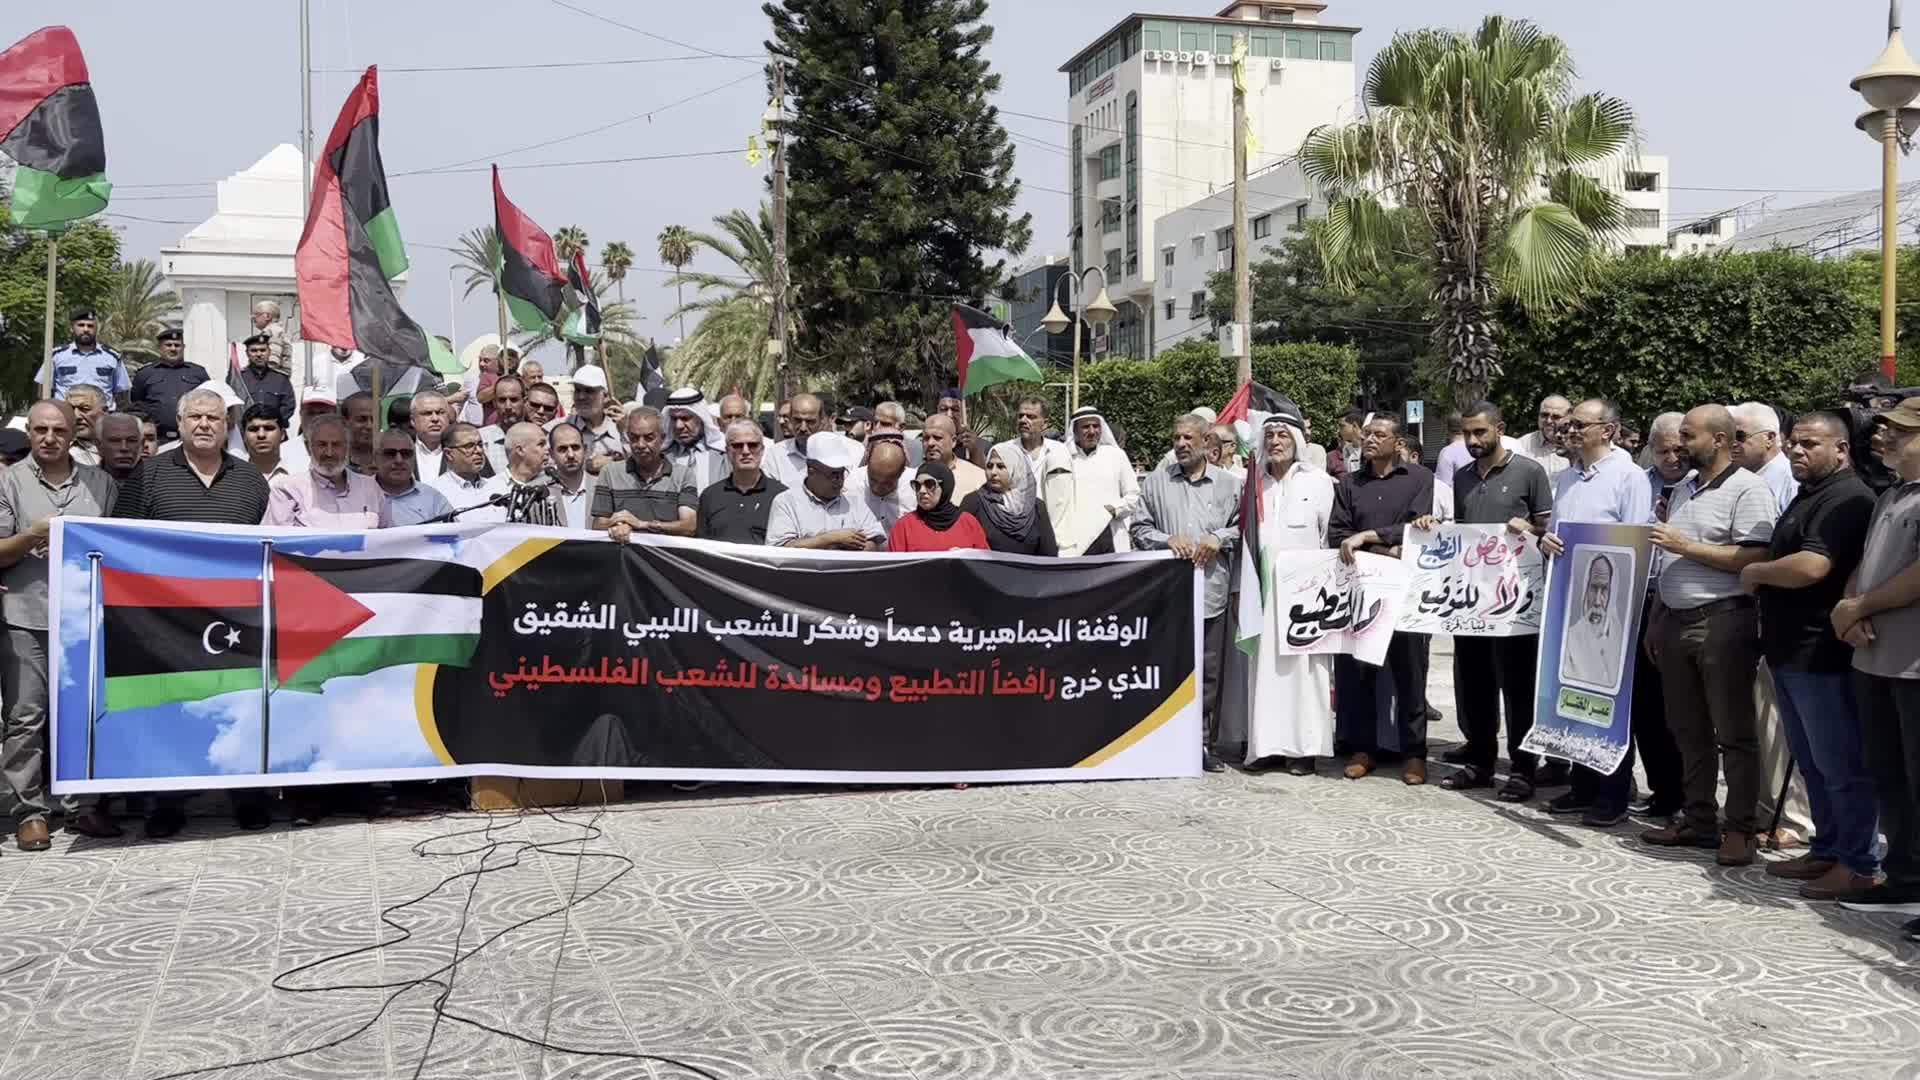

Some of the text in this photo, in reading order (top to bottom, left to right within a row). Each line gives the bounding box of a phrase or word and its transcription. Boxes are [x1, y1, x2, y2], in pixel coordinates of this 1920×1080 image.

[513, 601, 1148, 651] الوقفة الجماهيرية دعماً وشكر للشعب الليبي الشقيق
[487, 656, 1160, 703] الذي خرج رافضاً التطبيع ومساندة للشعب الفلسطيني
